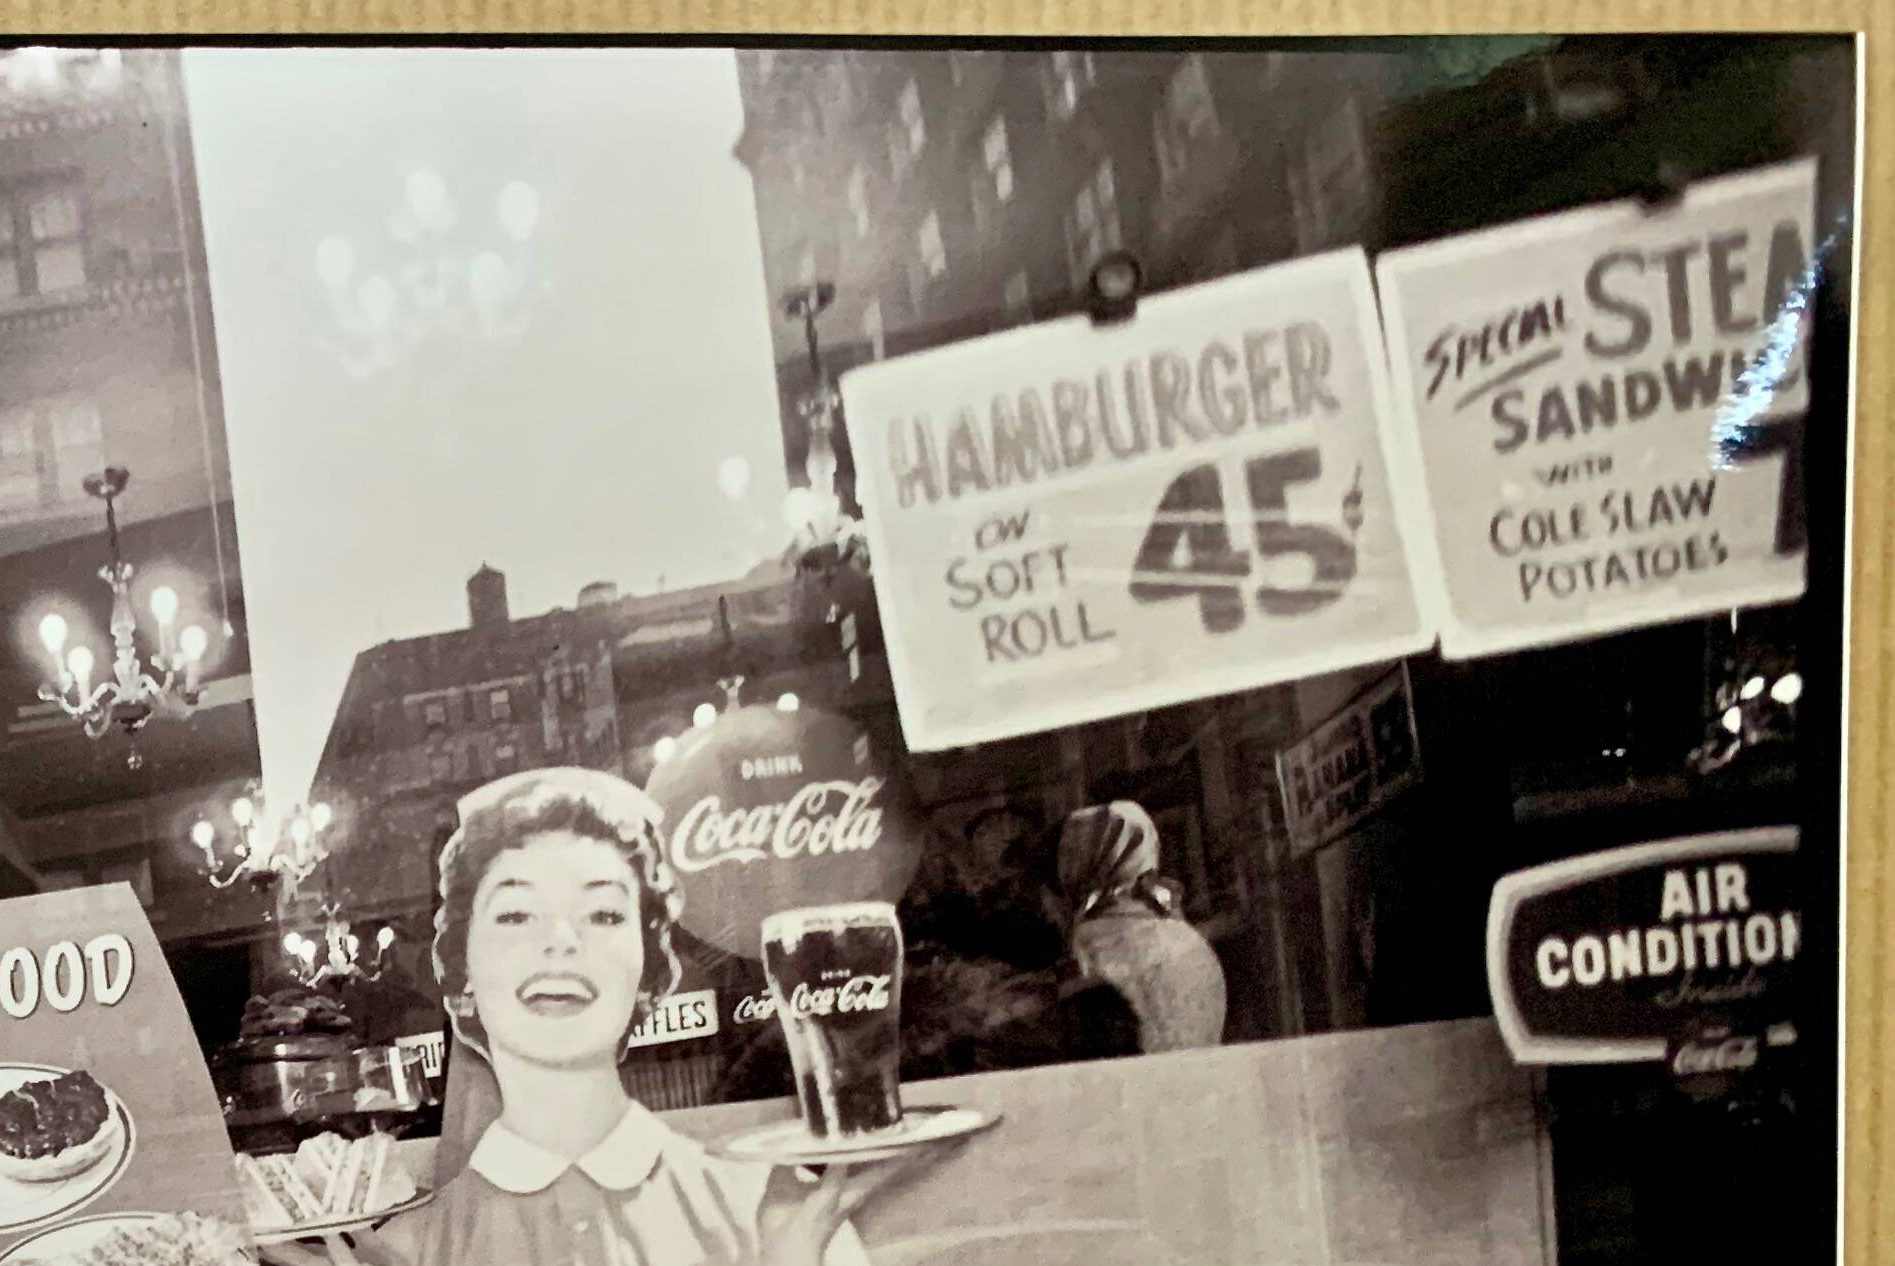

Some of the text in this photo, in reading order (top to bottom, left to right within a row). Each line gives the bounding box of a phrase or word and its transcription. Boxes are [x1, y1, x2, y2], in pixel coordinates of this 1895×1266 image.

[888, 320, 1342, 509] HAMBURGER
[1536, 455, 1613, 485] WITH
[945, 542, 1070, 610] SOFT
[1519, 530, 1729, 602] POTATOES
[981, 601, 1117, 664] ROLL
[741, 754, 803, 780] DRINK
[671, 775, 887, 872] Coca-Cola
[1661, 862, 1751, 921] AIR
